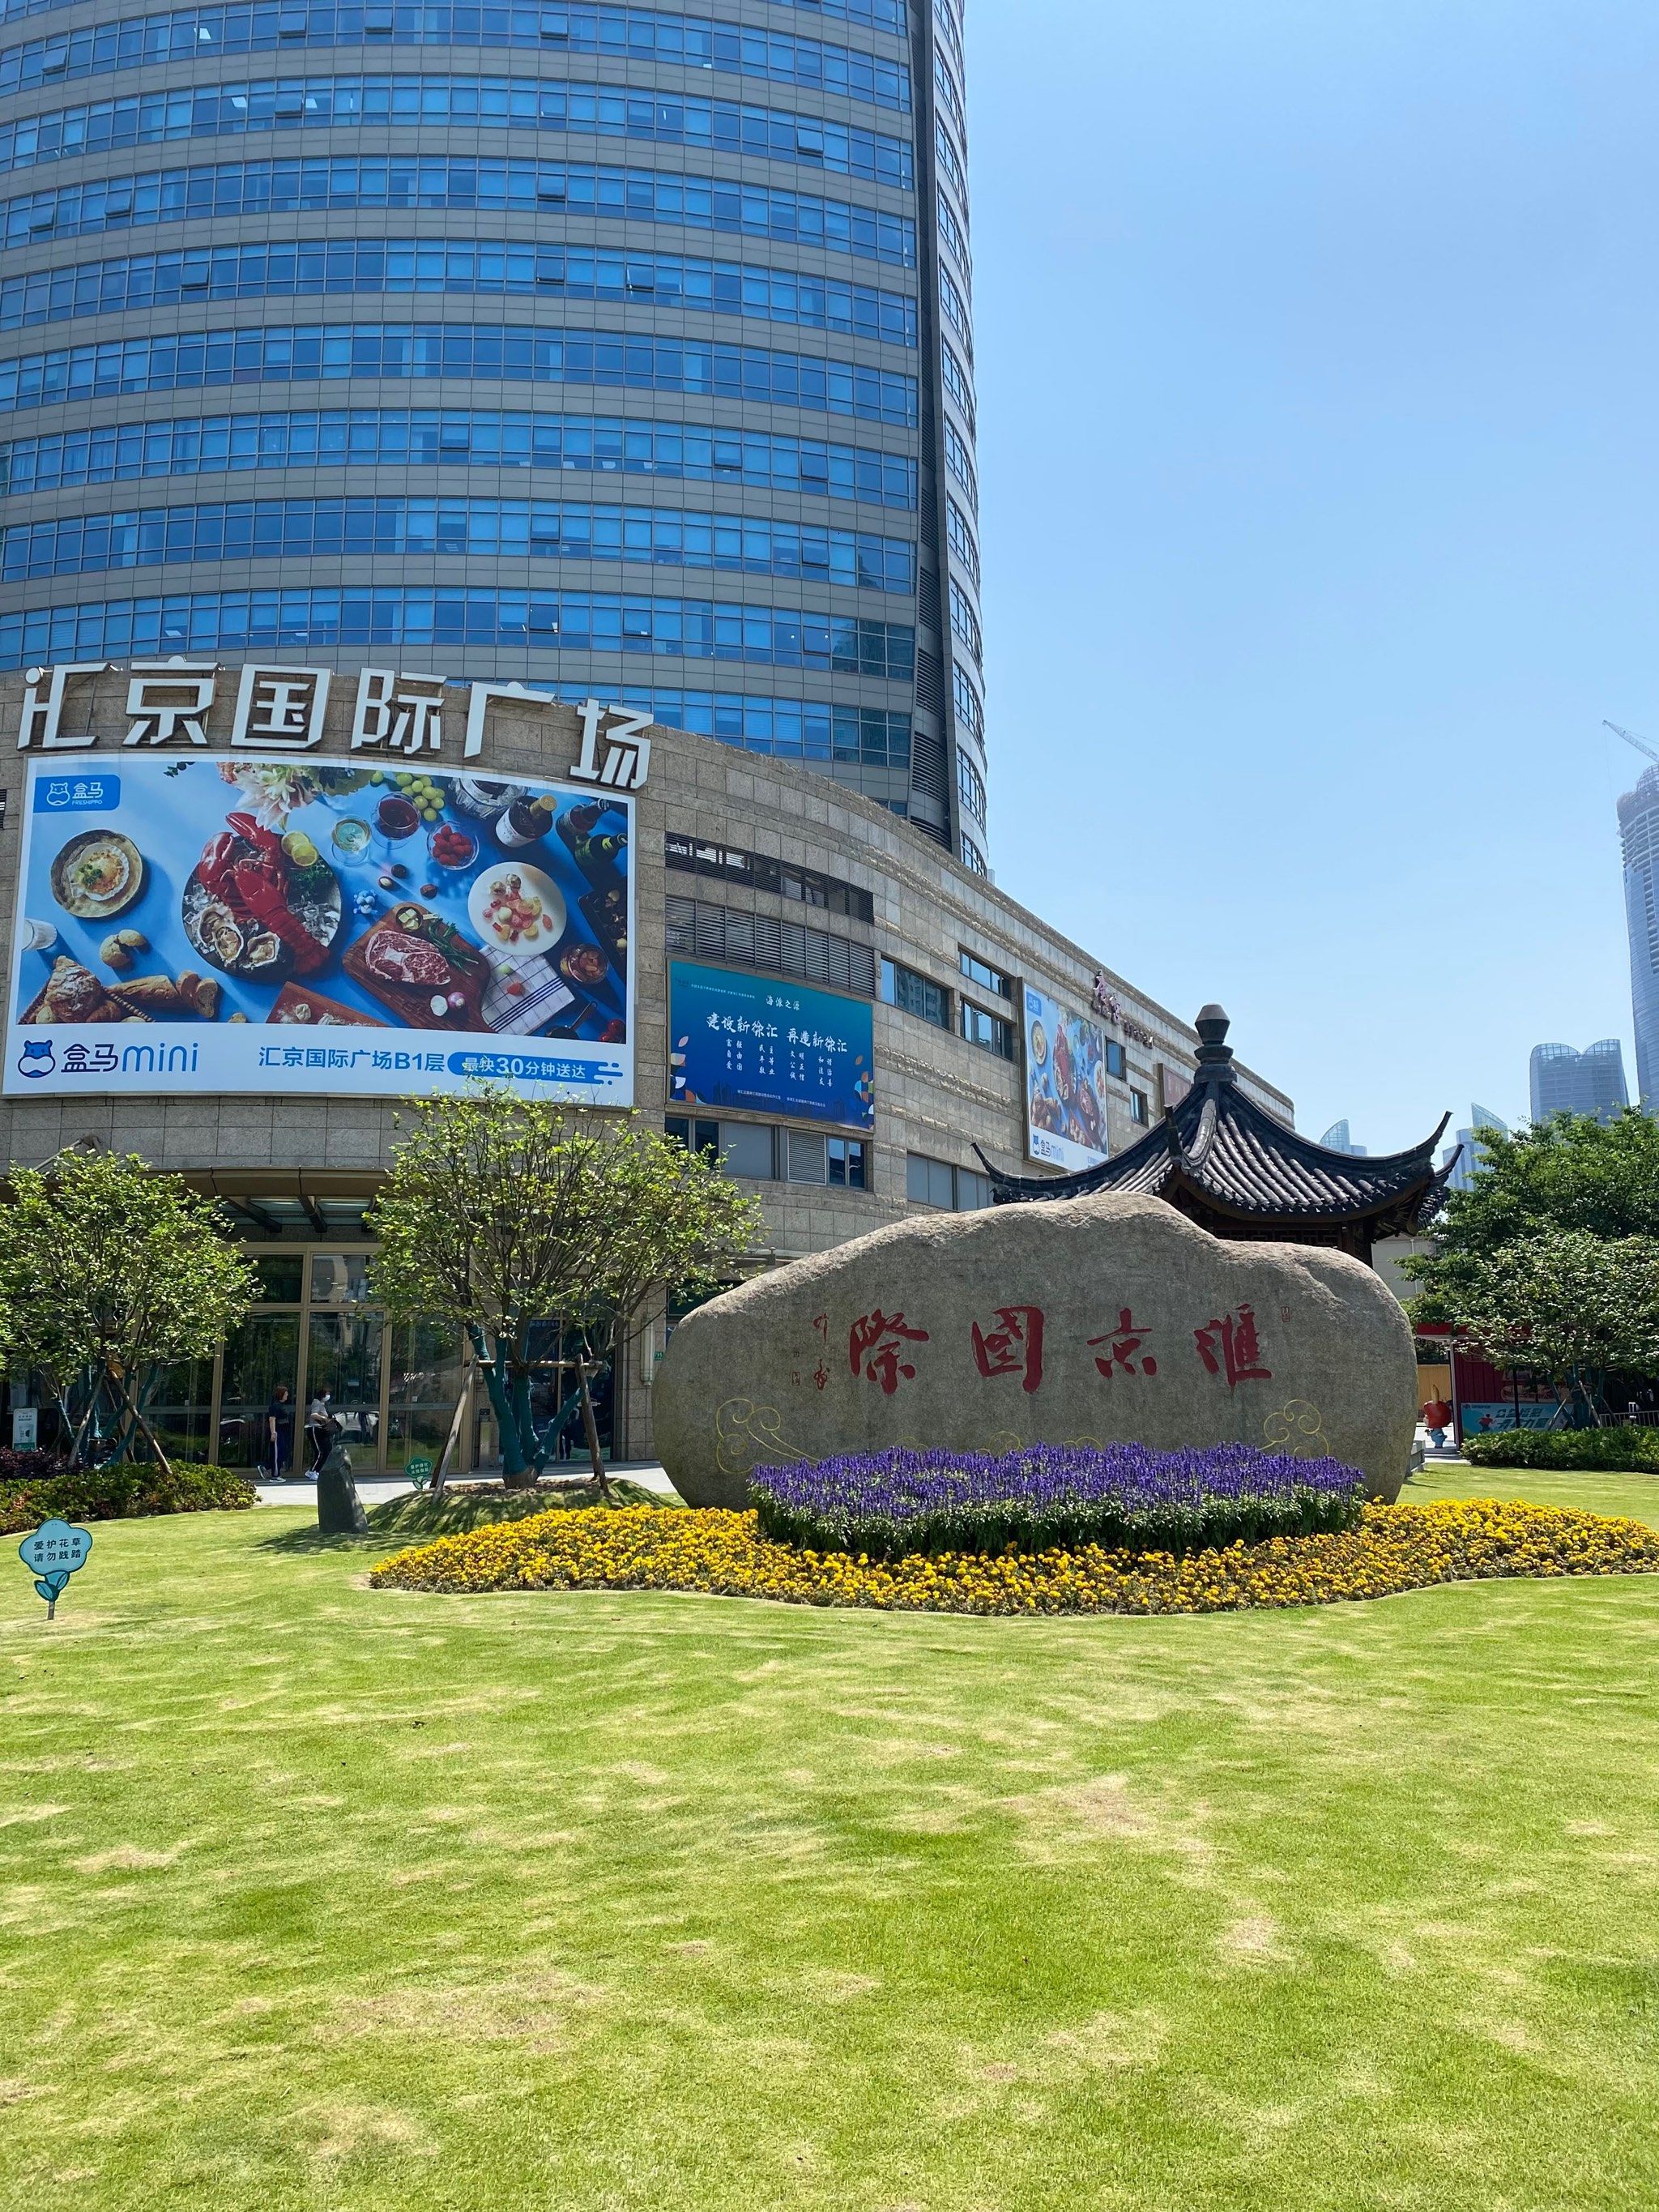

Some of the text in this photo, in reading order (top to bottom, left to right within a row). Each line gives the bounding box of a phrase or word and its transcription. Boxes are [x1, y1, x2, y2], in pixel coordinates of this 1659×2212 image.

[17, 655, 654, 790] 汇京国际广场
[72, 782, 103, 798] 盒马
[766, 995, 800, 1011] 海派之源
[706, 1012, 847, 1053] 建设新徐汇 再造新徐汇
[258, 1046, 445, 1072] 汇京国际广场B1层
[34, 1537, 81, 1550] 爱护花草
[34, 1549, 81, 1562] 请勿践踏
